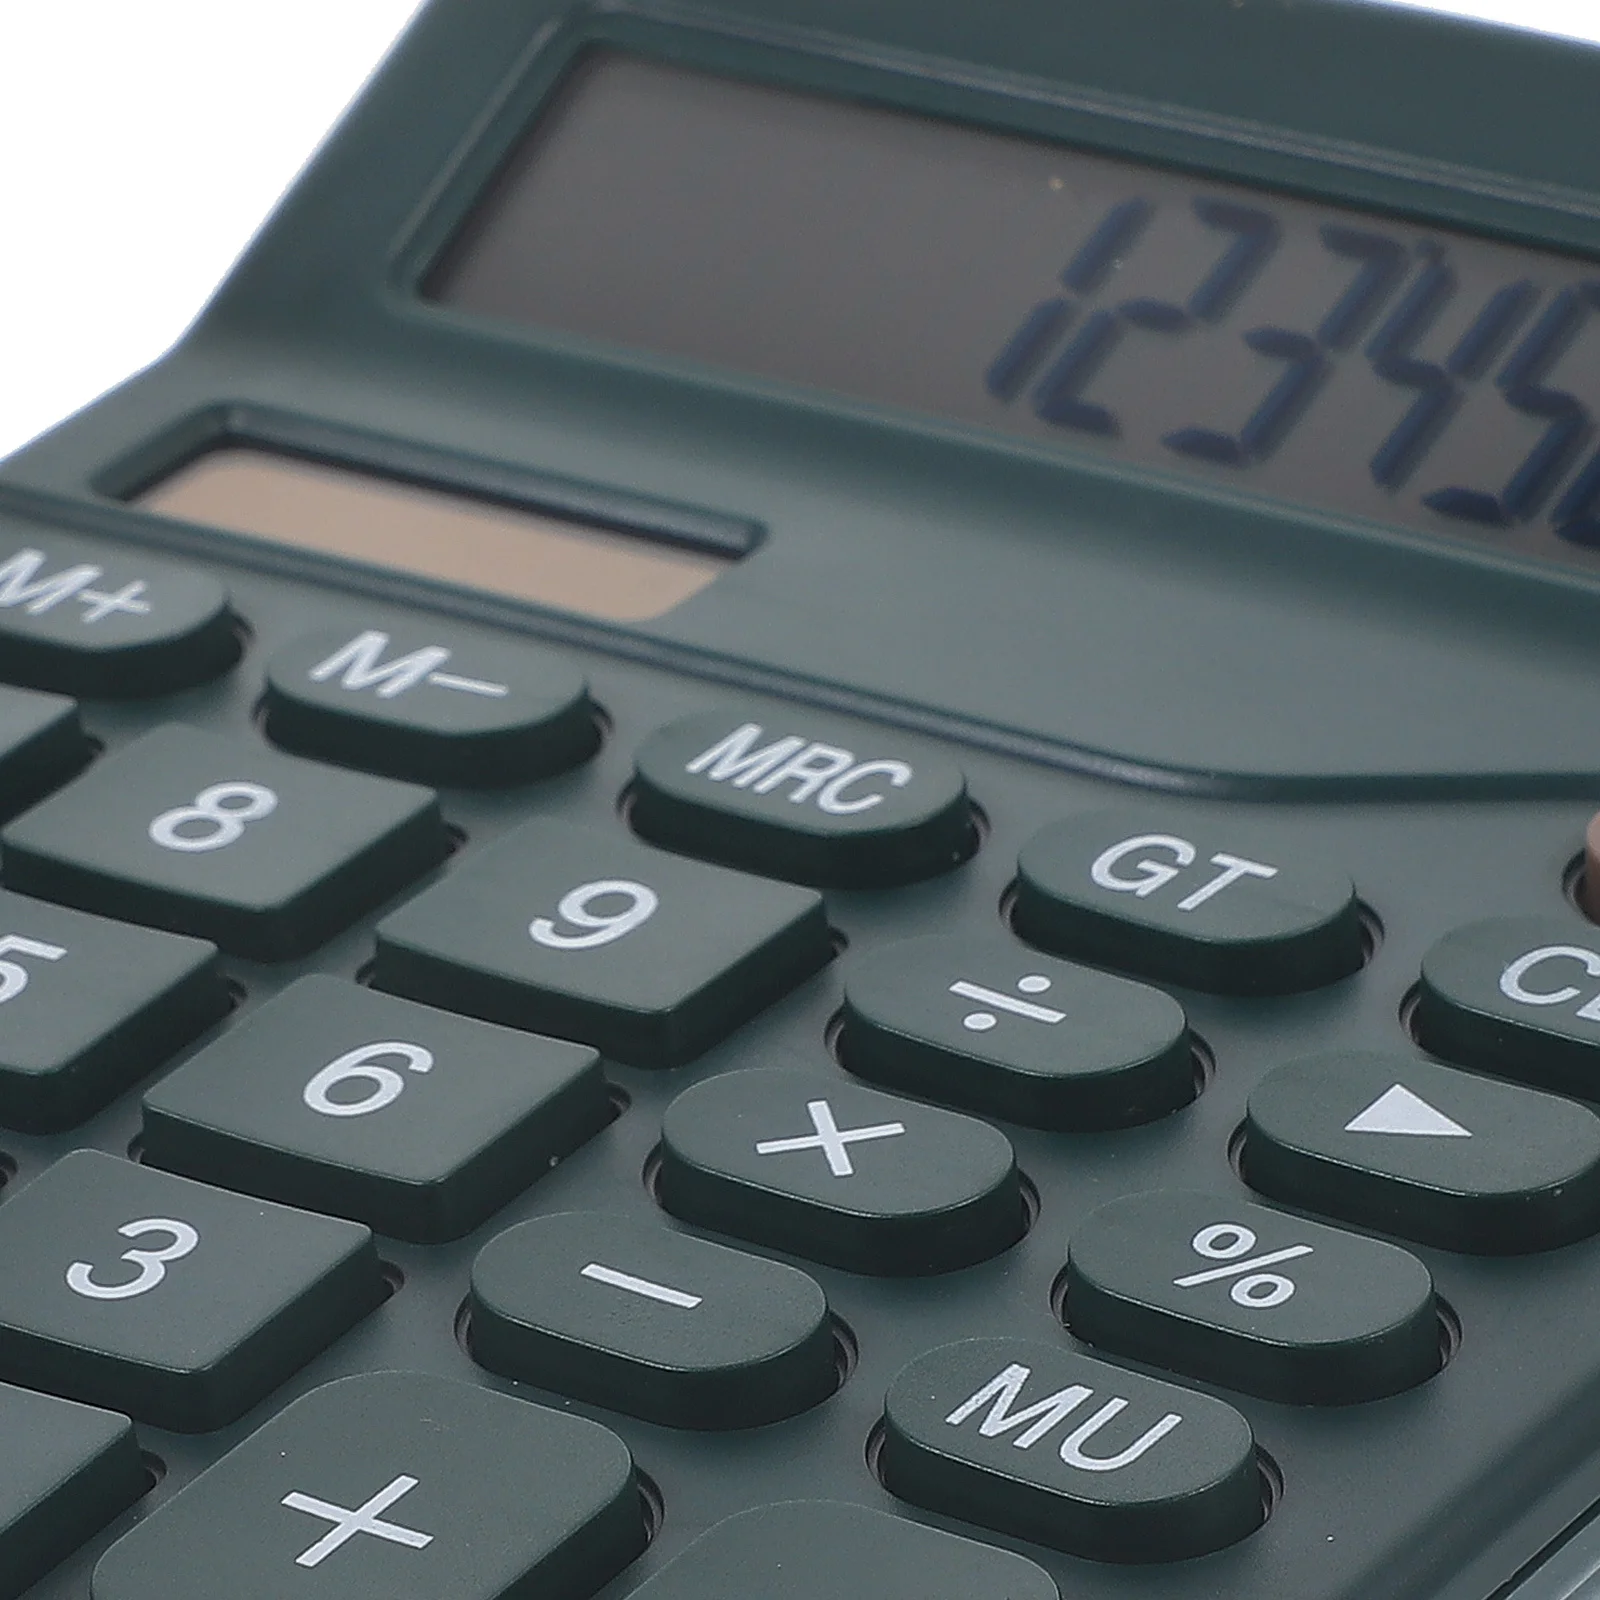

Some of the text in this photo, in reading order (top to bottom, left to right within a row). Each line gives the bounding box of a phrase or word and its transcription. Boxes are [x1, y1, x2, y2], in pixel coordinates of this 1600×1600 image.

[0, 548, 154, 624] M+
[685, 722, 914, 815] MRC
[148, 781, 279, 852] 8
[1090, 833, 1280, 912] GT
[528, 879, 660, 950] 9
[1499, 945, 1600, 1021] C
[303, 1041, 434, 1117] 6
[65, 1217, 200, 1300] 3
[1173, 1222, 1314, 1309] %
[945, 1363, 1183, 1473] MU
